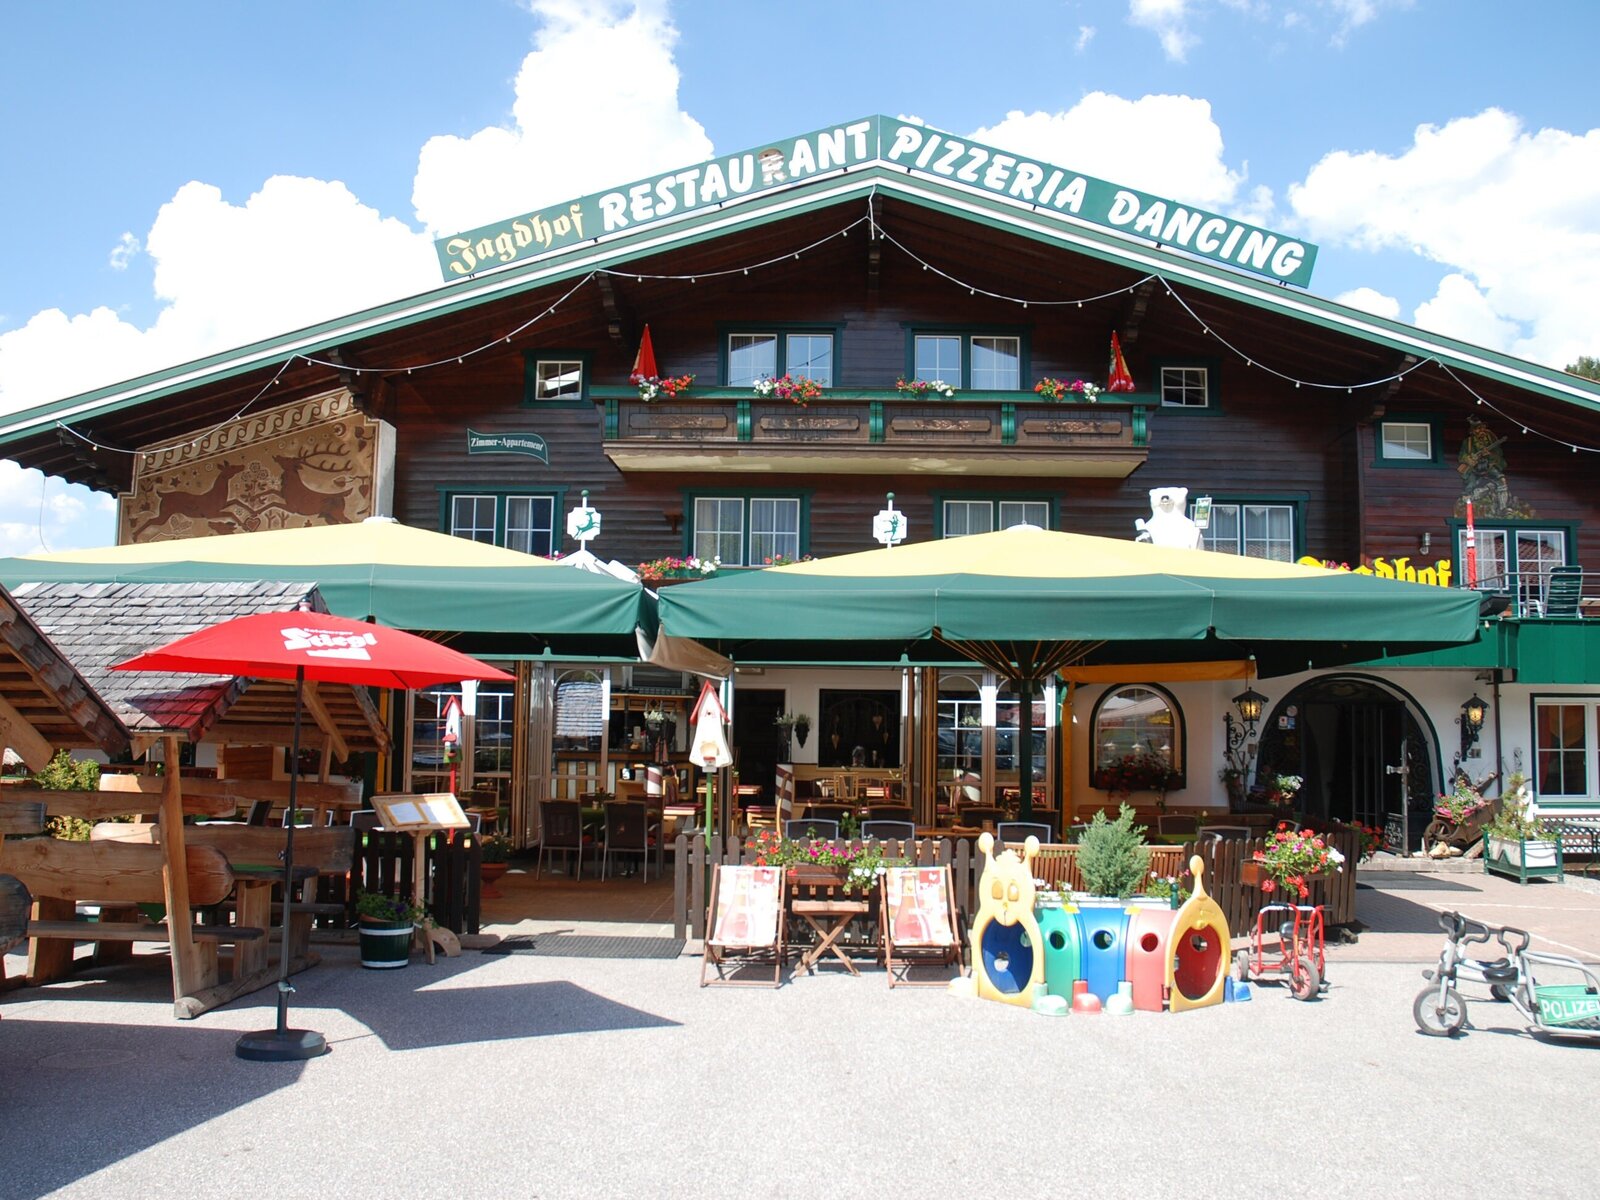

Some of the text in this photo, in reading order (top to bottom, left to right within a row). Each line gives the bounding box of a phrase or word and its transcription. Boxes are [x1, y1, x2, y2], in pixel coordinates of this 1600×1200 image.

[446, 121, 871, 275] Jagdhof RESTAURANT
[888, 126, 1306, 277] PIZZERIA DANCING
[470, 437, 544, 451] Zimmer-Appartement
